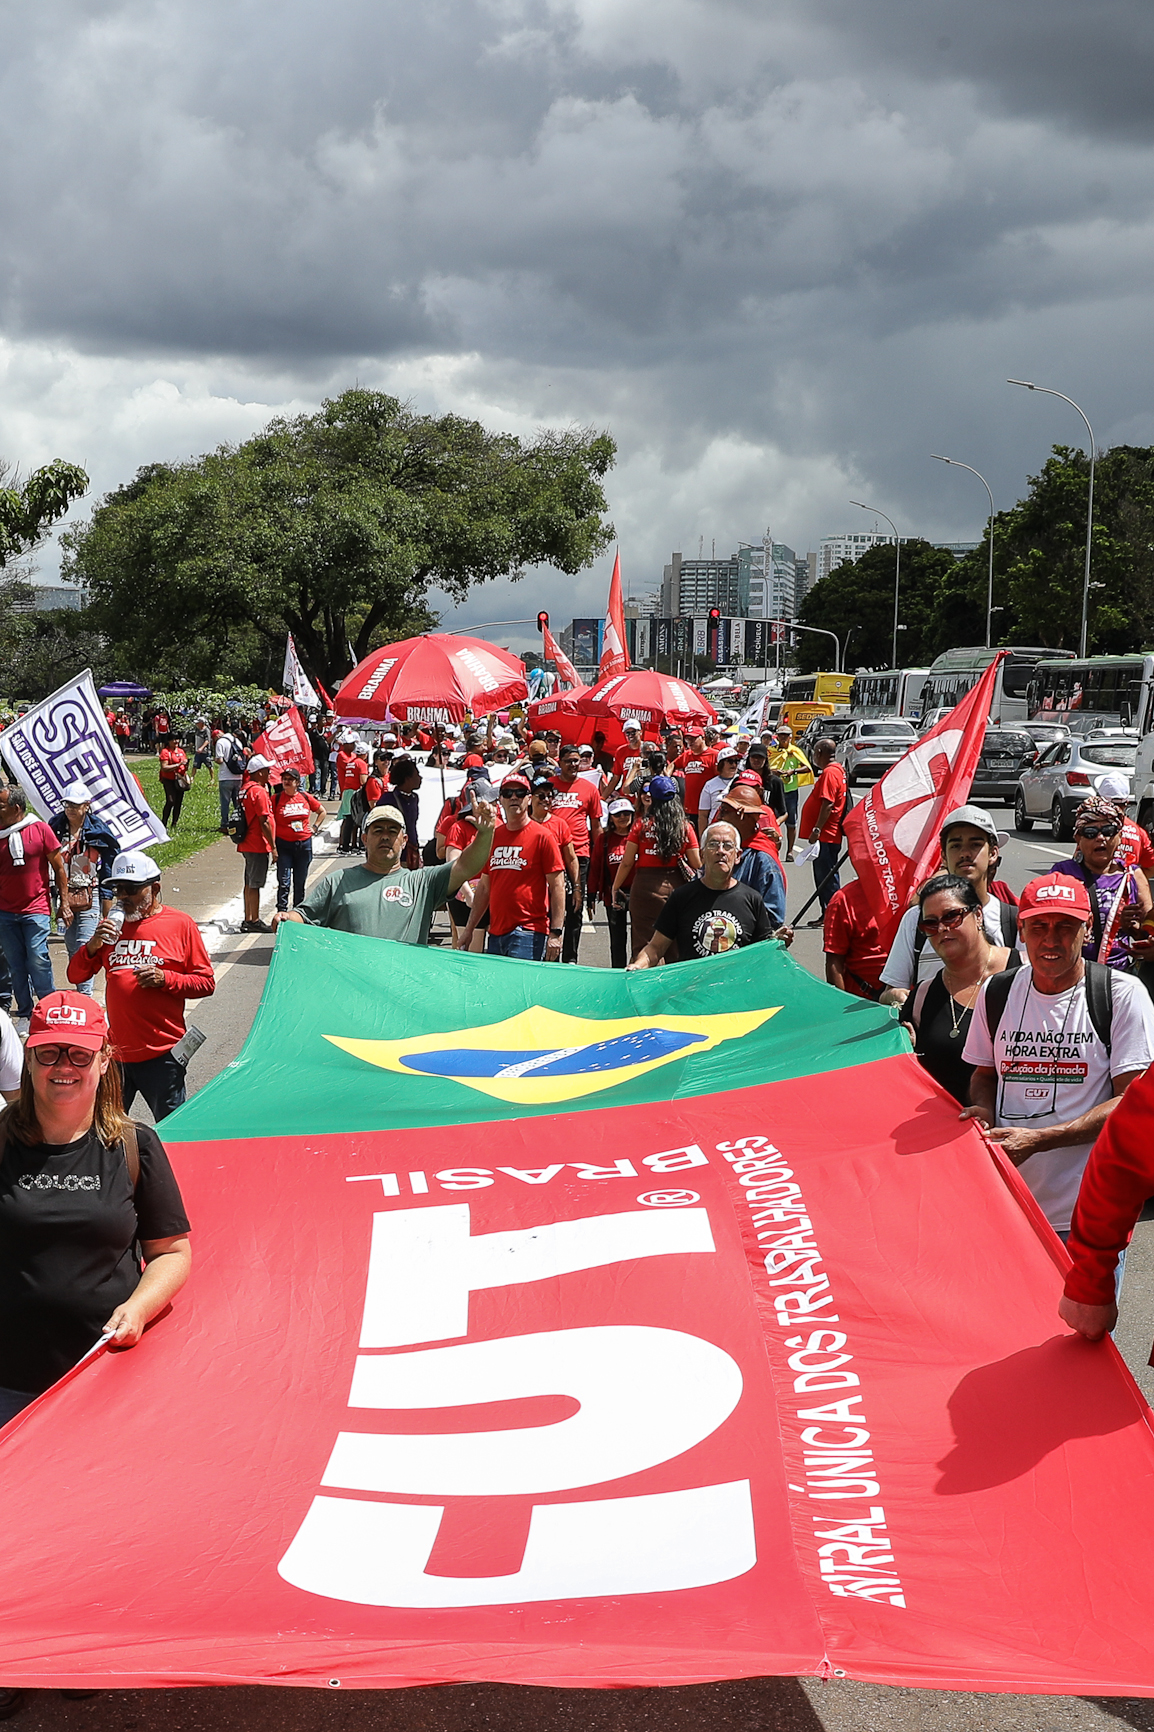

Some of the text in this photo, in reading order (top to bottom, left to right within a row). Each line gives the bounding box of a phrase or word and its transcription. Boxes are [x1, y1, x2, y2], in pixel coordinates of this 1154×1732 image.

[697, 630, 705, 647] BRB
[358, 658, 398, 700] BRAHMA
[455, 648, 499, 692] BRAHMA
[592, 676, 627, 702] BRAHMA
[666, 681, 690, 712] BRAHMA
[407, 707, 449, 722] BRAHMA
[620, 707, 651, 722] BRAHMA
[12, 733, 65, 814] SÃO JOSÉ DO RIO PR
[866, 810, 880, 841] ÚNICA
[873, 841, 889, 866] DOS
[494, 846, 523, 858] CUT
[1036, 885, 1071, 897] CUT
[692, 910, 743, 935] NOSSO TRABALHO
[115, 940, 157, 955] CUT
[693, 940, 710, 957] TEM
[49, 1007, 84, 1020] CUT
[1000, 1029, 1093, 1044] A VIDA NÃO TEM
[1005, 1045, 1080, 1058] HORA EXTRA
[1034, 1064, 1048, 1074] da
[1026, 1089, 1049, 1097] CUT
[346, 1144, 709, 1196] BRASIL
[715, 1135, 839, 1327] TRABALHADORES
[784, 1331, 860, 1393] DOS
[278, 1203, 757, 1609] CUT
[788, 1396, 881, 1499] ÚNICA
